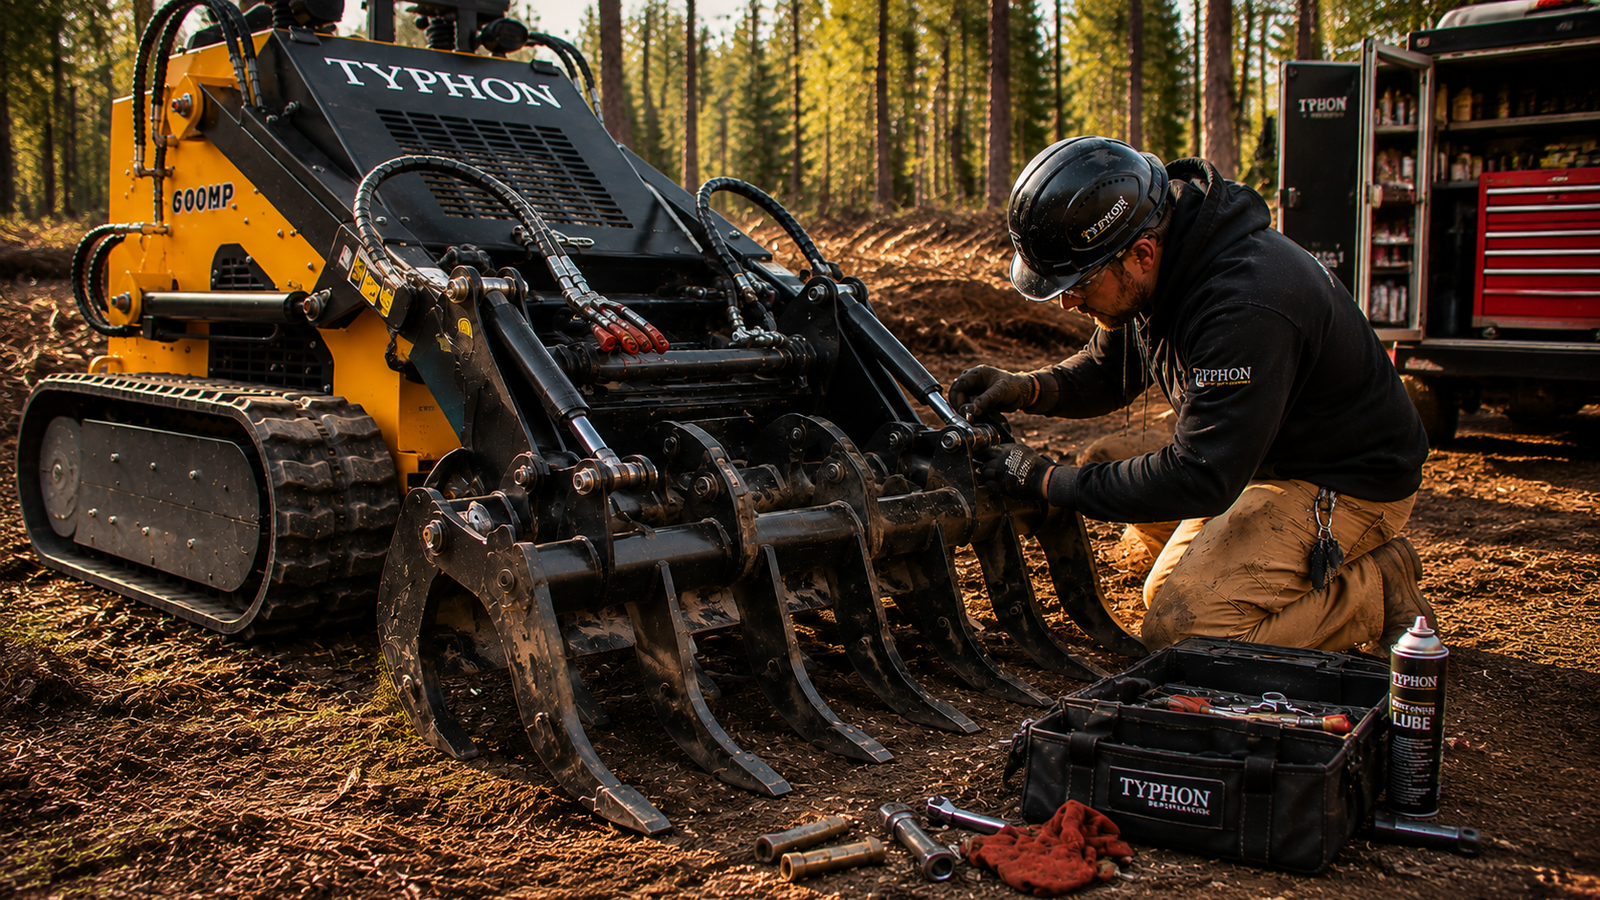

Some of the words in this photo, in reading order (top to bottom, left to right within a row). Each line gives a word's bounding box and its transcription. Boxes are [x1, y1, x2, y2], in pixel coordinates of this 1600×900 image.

[324, 57, 562, 109] TYPHON
[1392, 670, 1438, 688] TYPHON
[1393, 712, 1431, 730] LUBE
[1120, 776, 1211, 808] TYPHON
